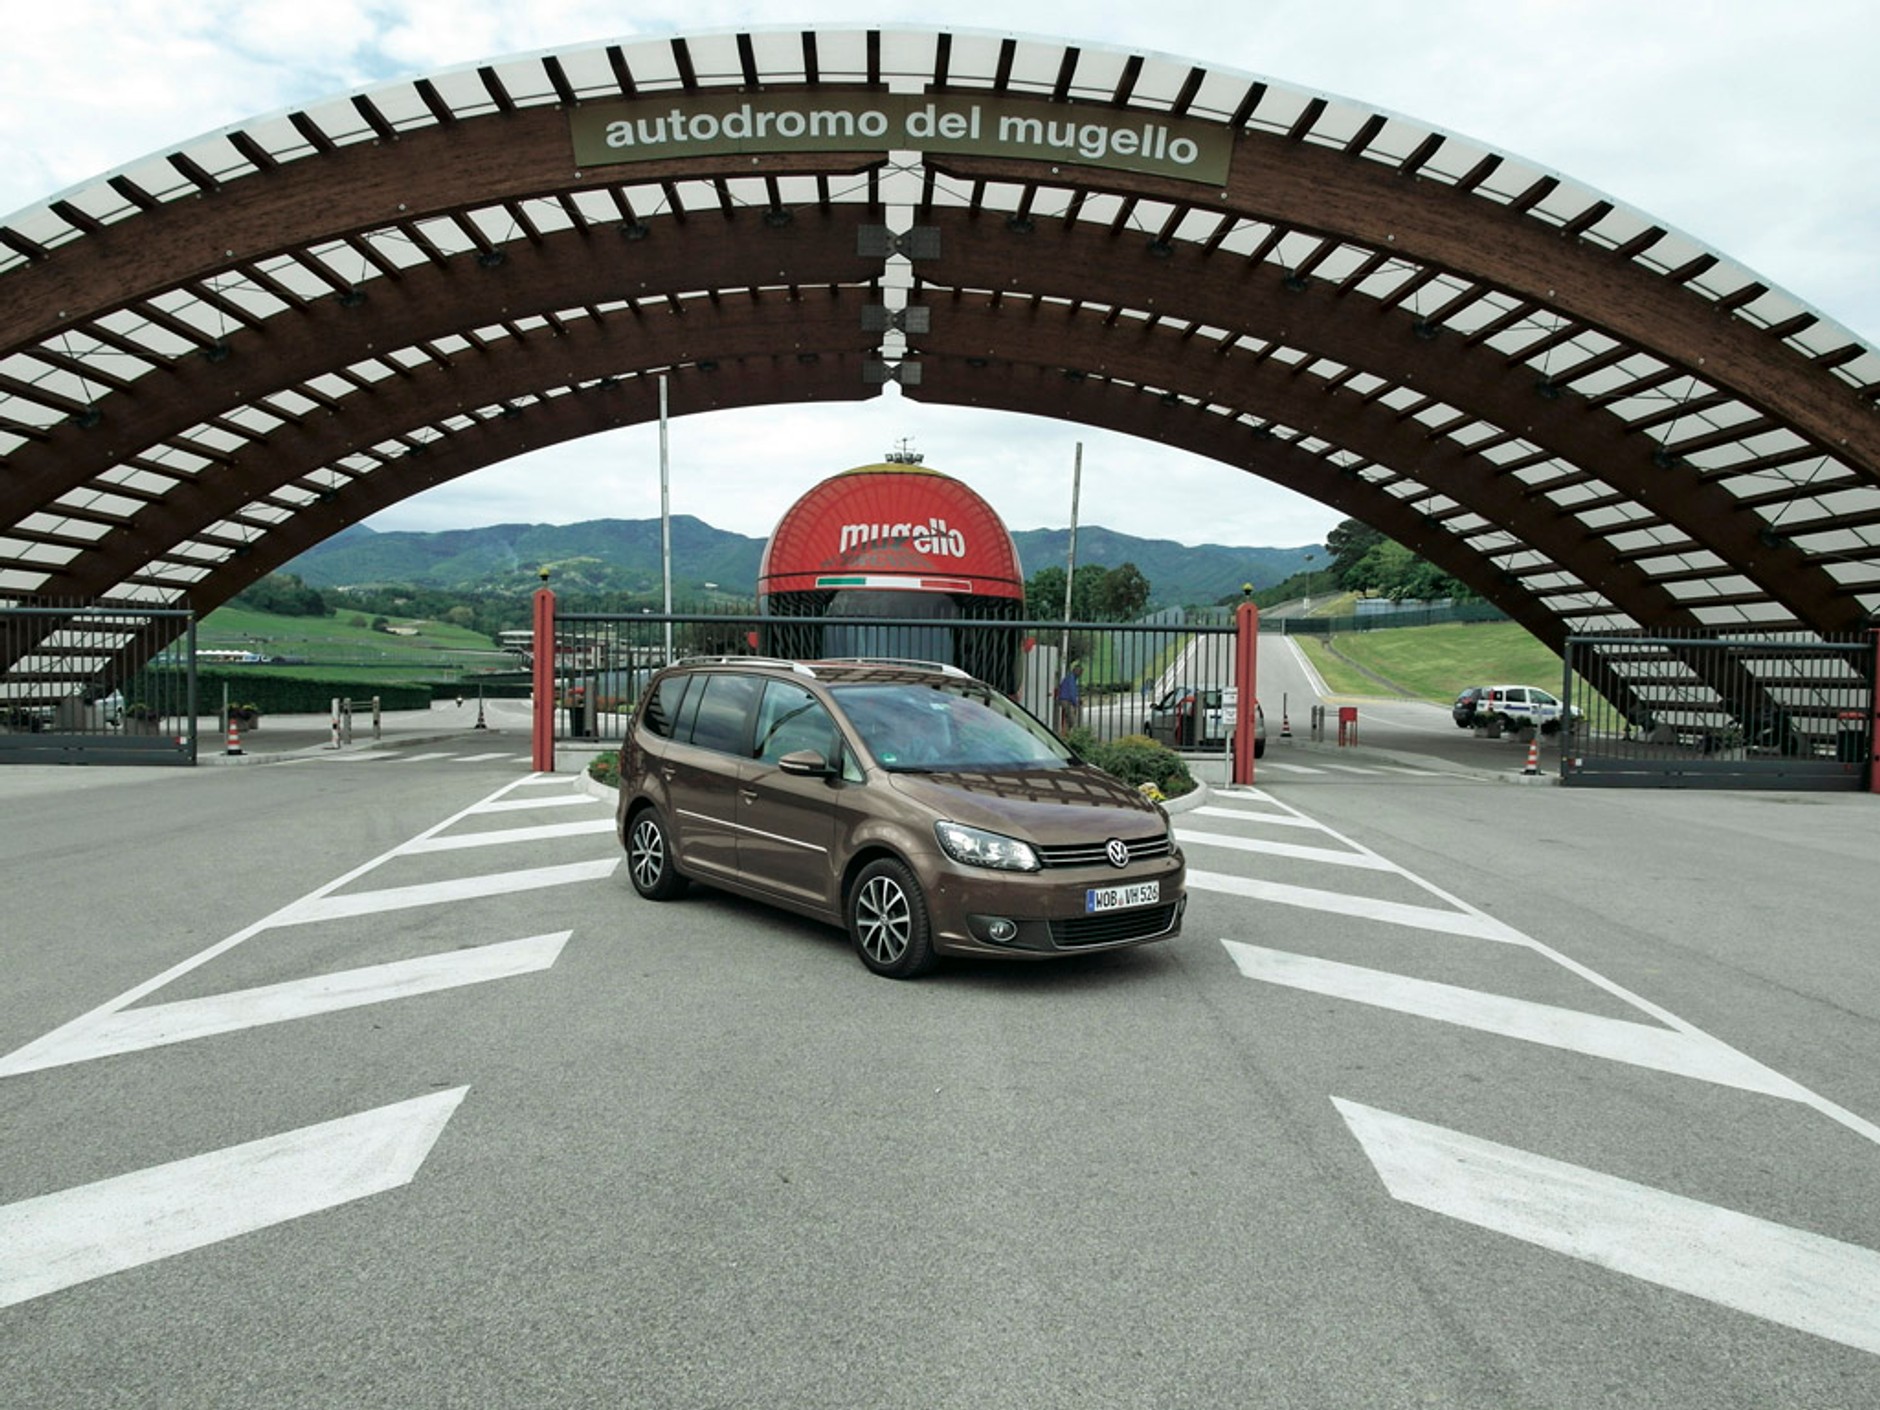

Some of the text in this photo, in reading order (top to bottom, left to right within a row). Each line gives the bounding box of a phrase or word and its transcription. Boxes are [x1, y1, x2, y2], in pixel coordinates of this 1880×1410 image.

[605, 104, 1198, 164] autodromo del mugello
[839, 517, 966, 558] mugello
[1096, 890, 1118, 908] WOB
[1140, 885, 1158, 902] 526
